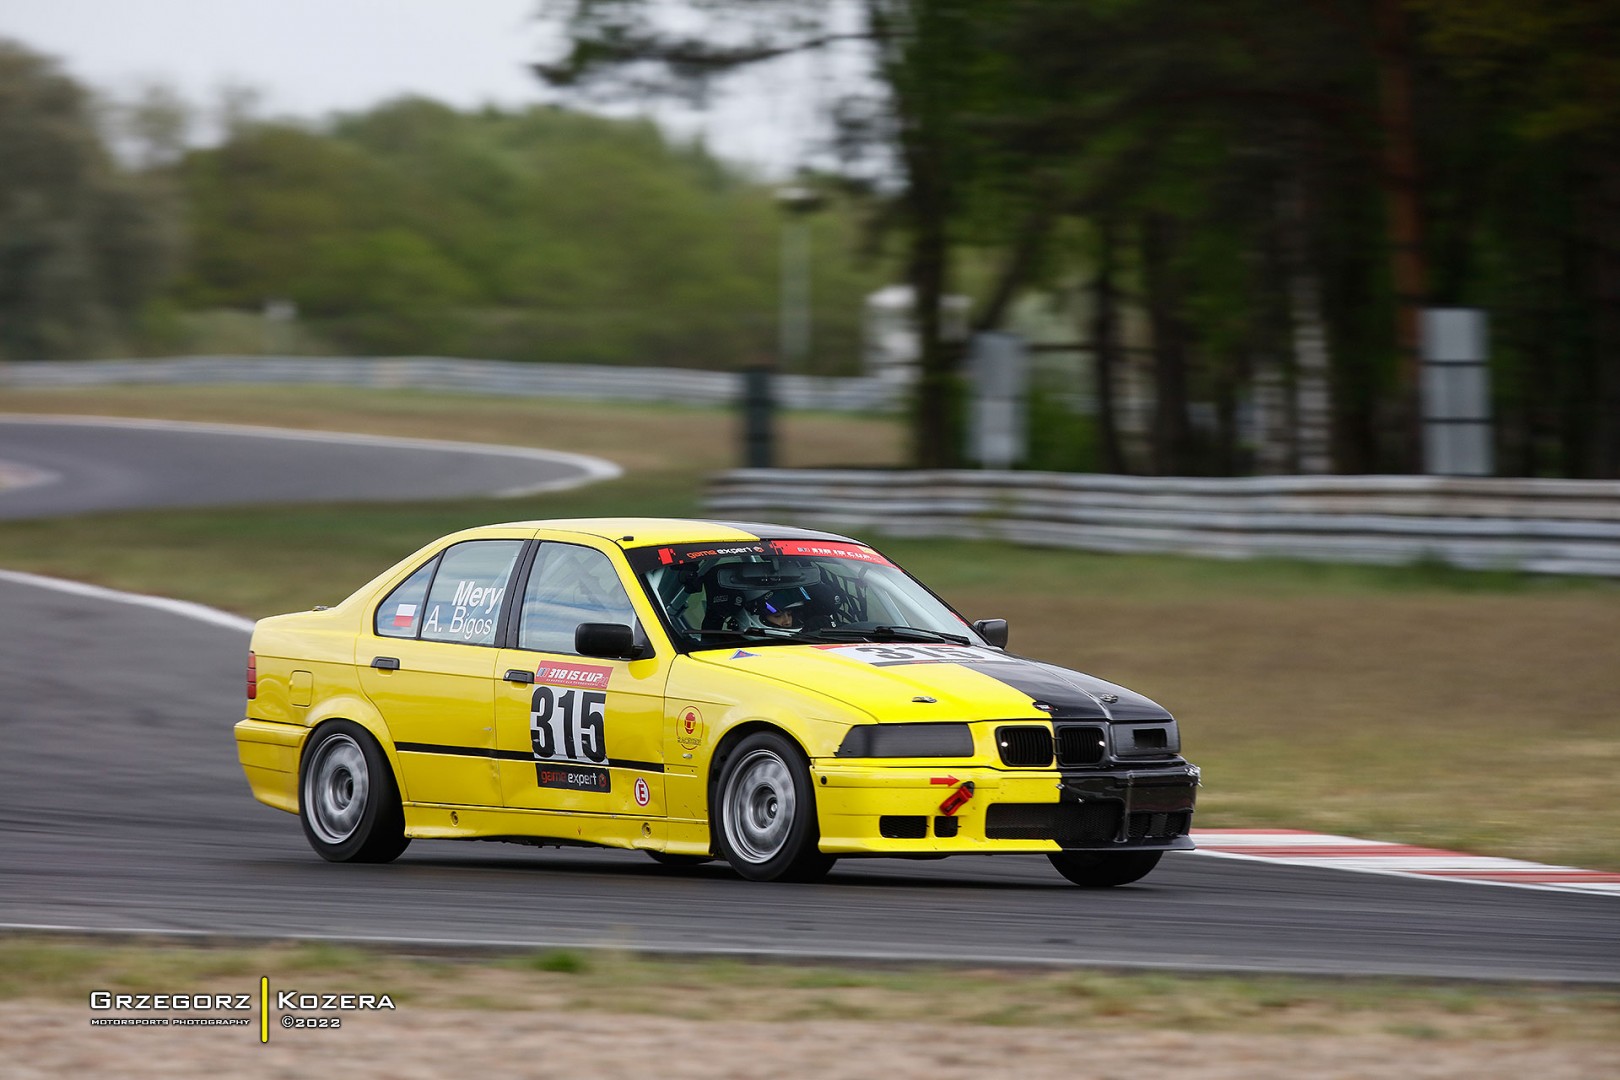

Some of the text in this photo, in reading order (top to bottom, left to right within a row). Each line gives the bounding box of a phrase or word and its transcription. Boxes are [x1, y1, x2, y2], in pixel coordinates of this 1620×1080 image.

[452, 580, 504, 614] Mery
[423, 605, 493, 639] A. Bigos
[856, 647, 985, 660] 315
[548, 668, 568, 679] 318
[567, 670, 581, 681] IS
[579, 671, 604, 683] CUP
[530, 686, 606, 763] 315
[638, 783, 647, 802] E
